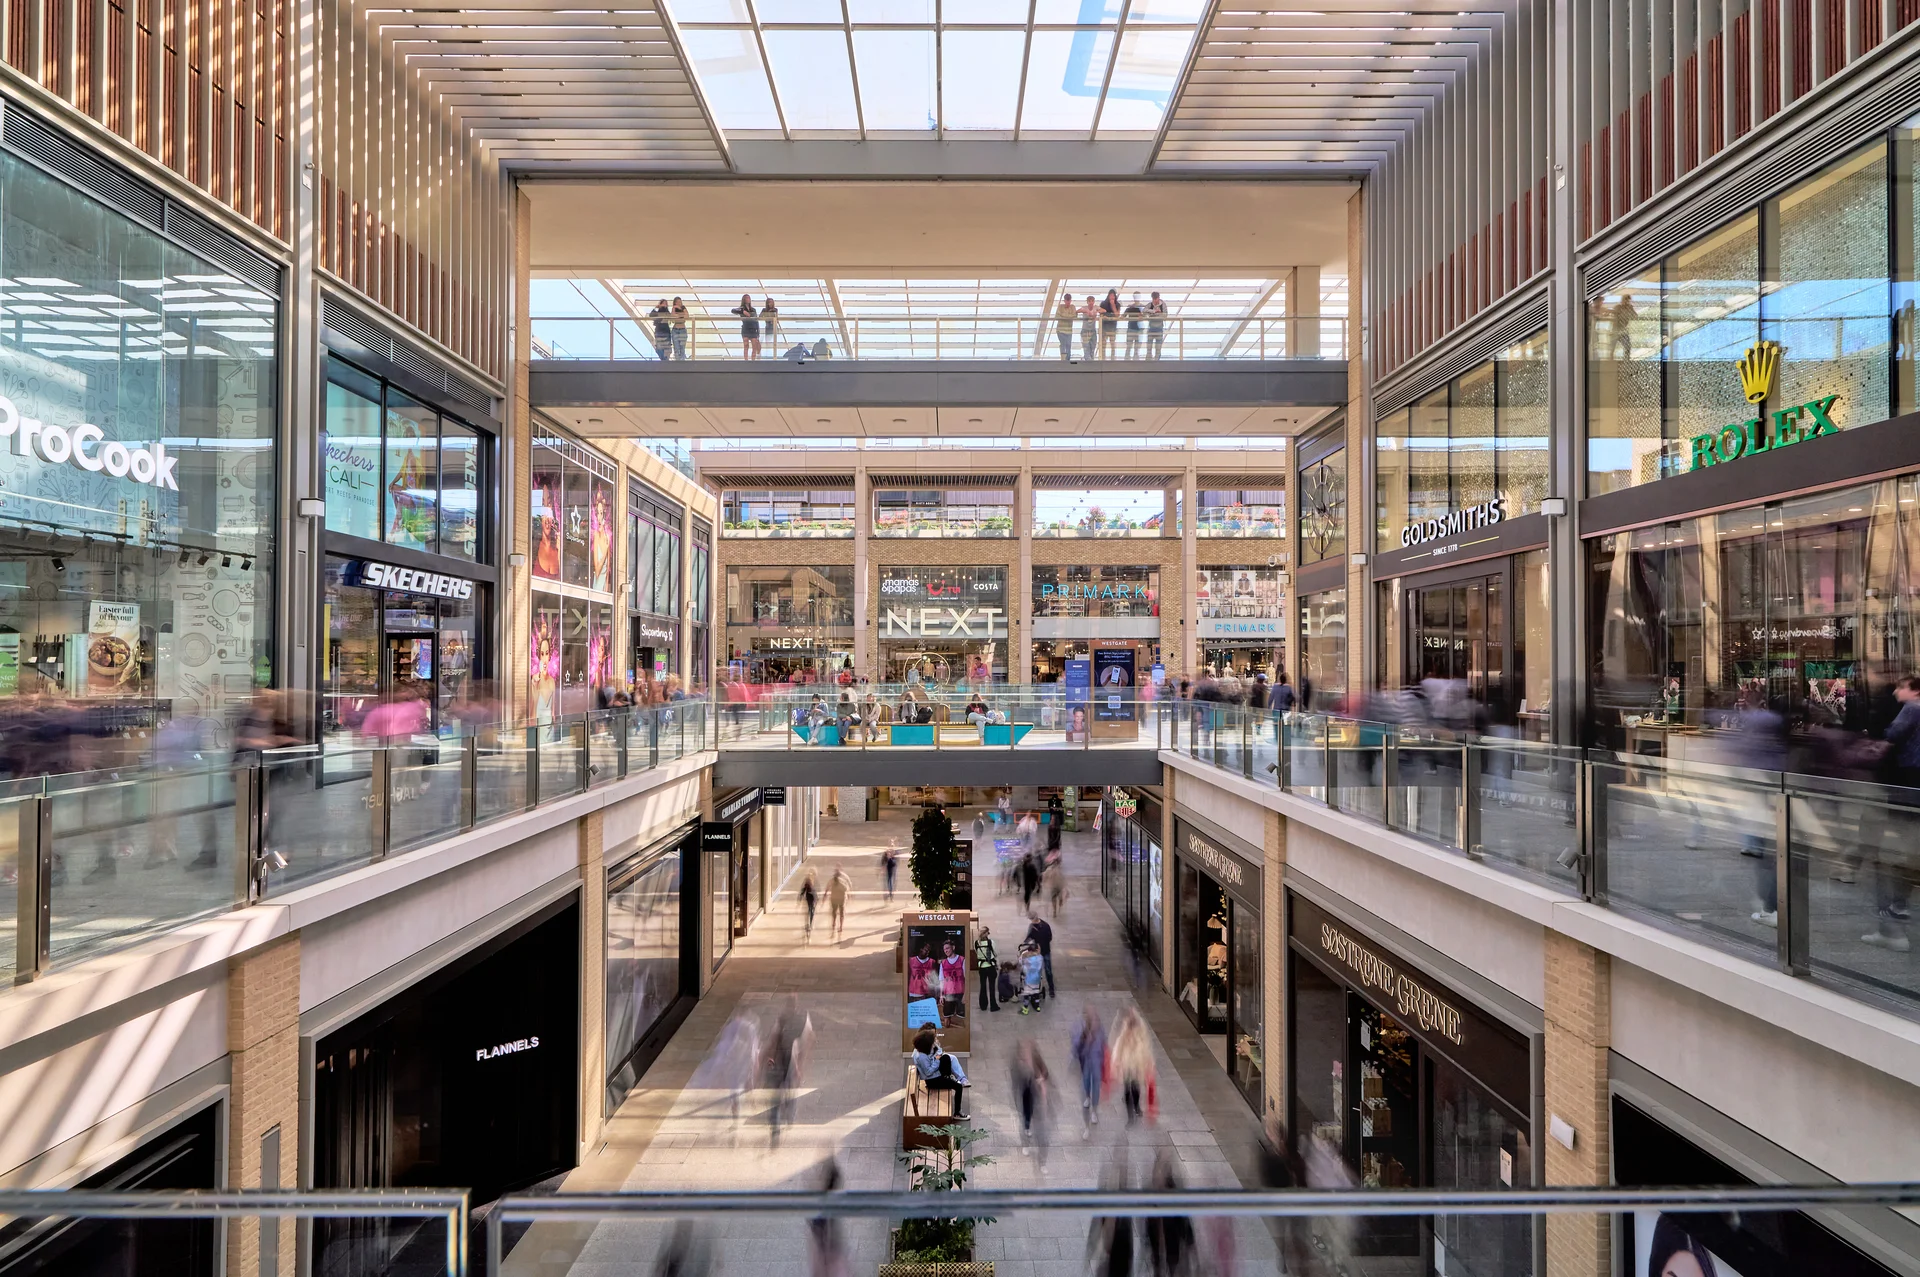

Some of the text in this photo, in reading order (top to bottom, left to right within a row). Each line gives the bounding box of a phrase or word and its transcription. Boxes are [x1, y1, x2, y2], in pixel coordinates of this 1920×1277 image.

[1690, 394, 1840, 471] ROLEX
[1401, 498, 1500, 548] GOLDSMITHS
[1433, 547, 1447, 556] SINCE
[365, 562, 473, 600] SKECHERS
[881, 583, 918, 594] &papas
[884, 579, 920, 587] mamas
[947, 586, 960, 594] TUI
[1042, 584, 1147, 599] PRIMARK
[98, 605, 134, 614] Easter full
[887, 608, 1003, 636] NEXT
[1215, 623, 1276, 633] PRIMARK
[641, 623, 668, 642] Superdrug
[770, 637, 813, 649] NEXT
[1321, 922, 1462, 1046] SØSTRENE GRENE
[476, 1036, 540, 1061] FLANNELS
